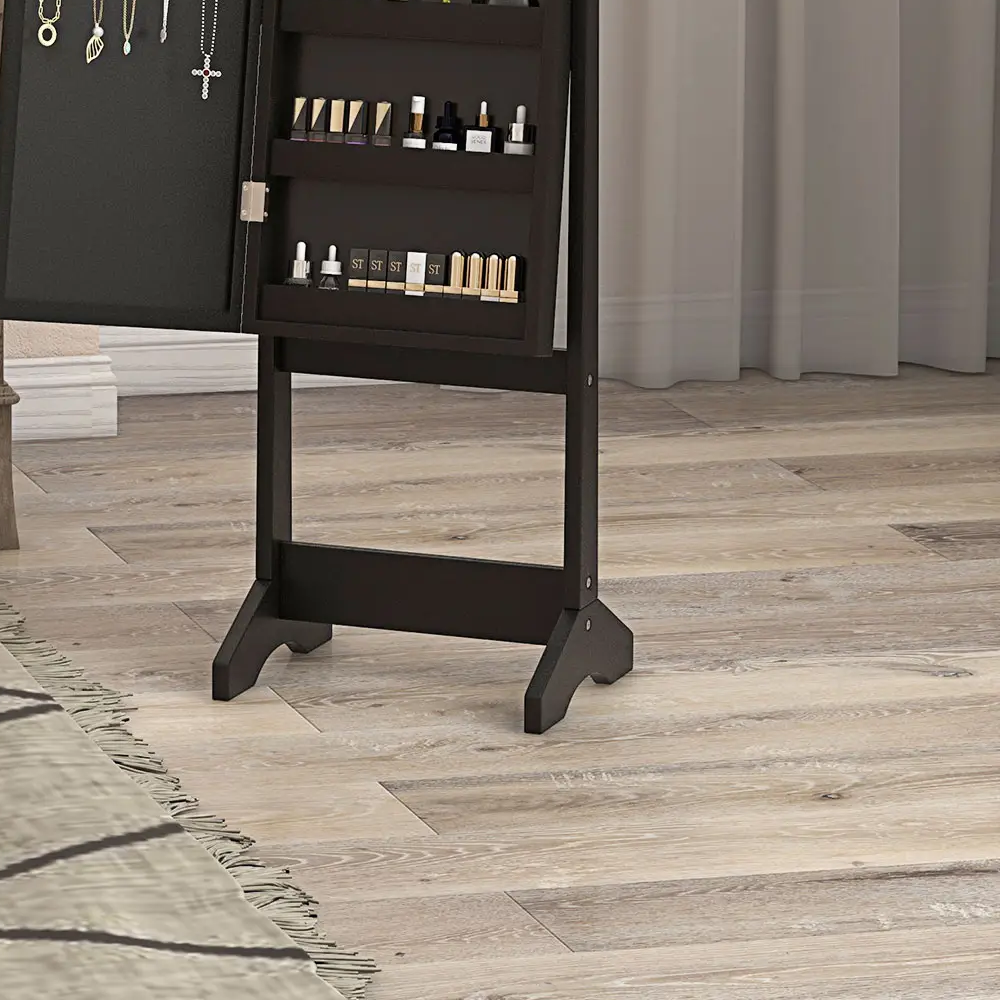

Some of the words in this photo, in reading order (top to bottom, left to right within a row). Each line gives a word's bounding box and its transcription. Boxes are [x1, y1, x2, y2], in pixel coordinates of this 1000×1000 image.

[352, 258, 364, 270] ST
[371, 260, 383, 271] ST
[390, 261, 402, 272] ST
[410, 262, 421, 273] ST
[428, 263, 441, 275] ST
